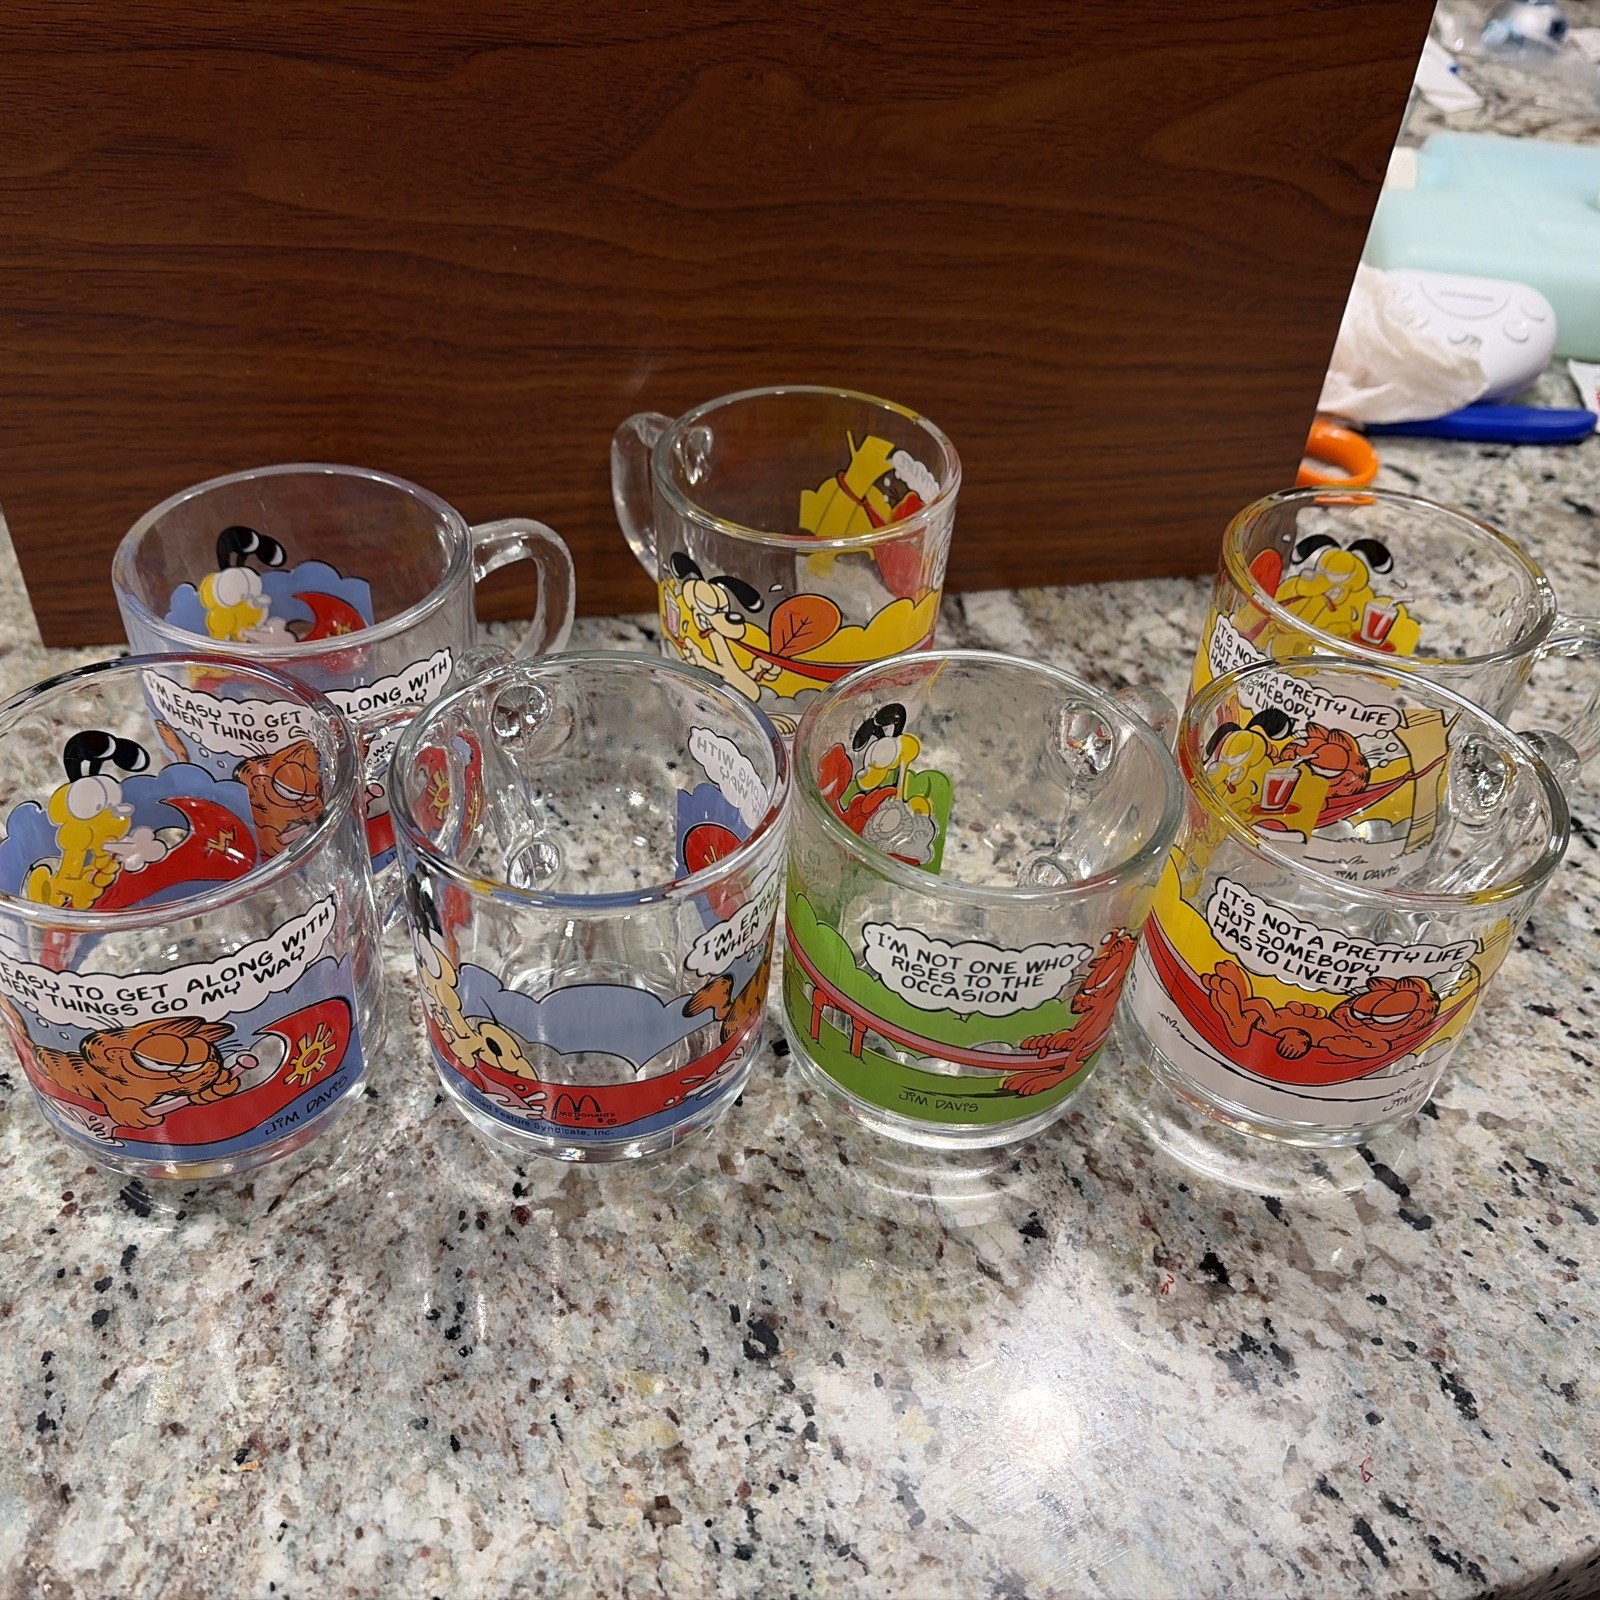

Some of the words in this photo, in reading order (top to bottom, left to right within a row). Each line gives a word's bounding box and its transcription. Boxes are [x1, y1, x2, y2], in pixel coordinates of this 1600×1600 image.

[173, 693, 222, 721] EASY
[228, 712, 255, 727] TO
[264, 710, 301, 728] GET
[408, 658, 447, 692] WITH
[1214, 635, 1232, 663] BUT
[1248, 678, 1316, 721] SOMEBODY
[1218, 621, 1233, 648] IT'S
[1270, 676, 1279, 685] A
[1283, 679, 1347, 715] PRETTY
[1351, 704, 1391, 726] LIFE
[158, 695, 204, 730] WHEN
[208, 721, 279, 743] THINGS
[0, 961, 60, 994] EASY
[68, 984, 104, 1001] TO
[116, 983, 169, 1002] GET
[186, 951, 274, 993] ALONG
[281, 906, 330, 952] WITH
[703, 927, 733, 956] I'M
[714, 917, 760, 962] WHEN
[878, 931, 909, 958] I'M
[916, 948, 963, 970] NOT
[969, 960, 1018, 975] ONE
[1025, 953, 1075, 975] WHO
[1213, 914, 1253, 952] HAS
[1254, 942, 1280, 965] TO
[1282, 958, 1333, 985] LIVE
[1332, 974, 1359, 989] IT
[1217, 900, 1256, 933] BUT
[1256, 928, 1381, 977] SOMEBODY
[1222, 886, 1256, 918] IT'S
[1262, 912, 1308, 941] NOT
[1306, 935, 1325, 950] A
[1332, 940, 1419, 964] PRETTY
[1423, 943, 1468, 965] LIFE
[0, 972, 40, 1001] HEN
[44, 992, 139, 1017] THINGS
[151, 997, 188, 1015] GO
[201, 980, 241, 1005] MY
[252, 945, 305, 984] WAY
[891, 955, 956, 985] RISES
[963, 974, 992, 989] TO
[1000, 973, 1045, 989] THE
[901, 974, 1018, 1004] OCCASION
[593, 1128, 615, 1136] Inc.
